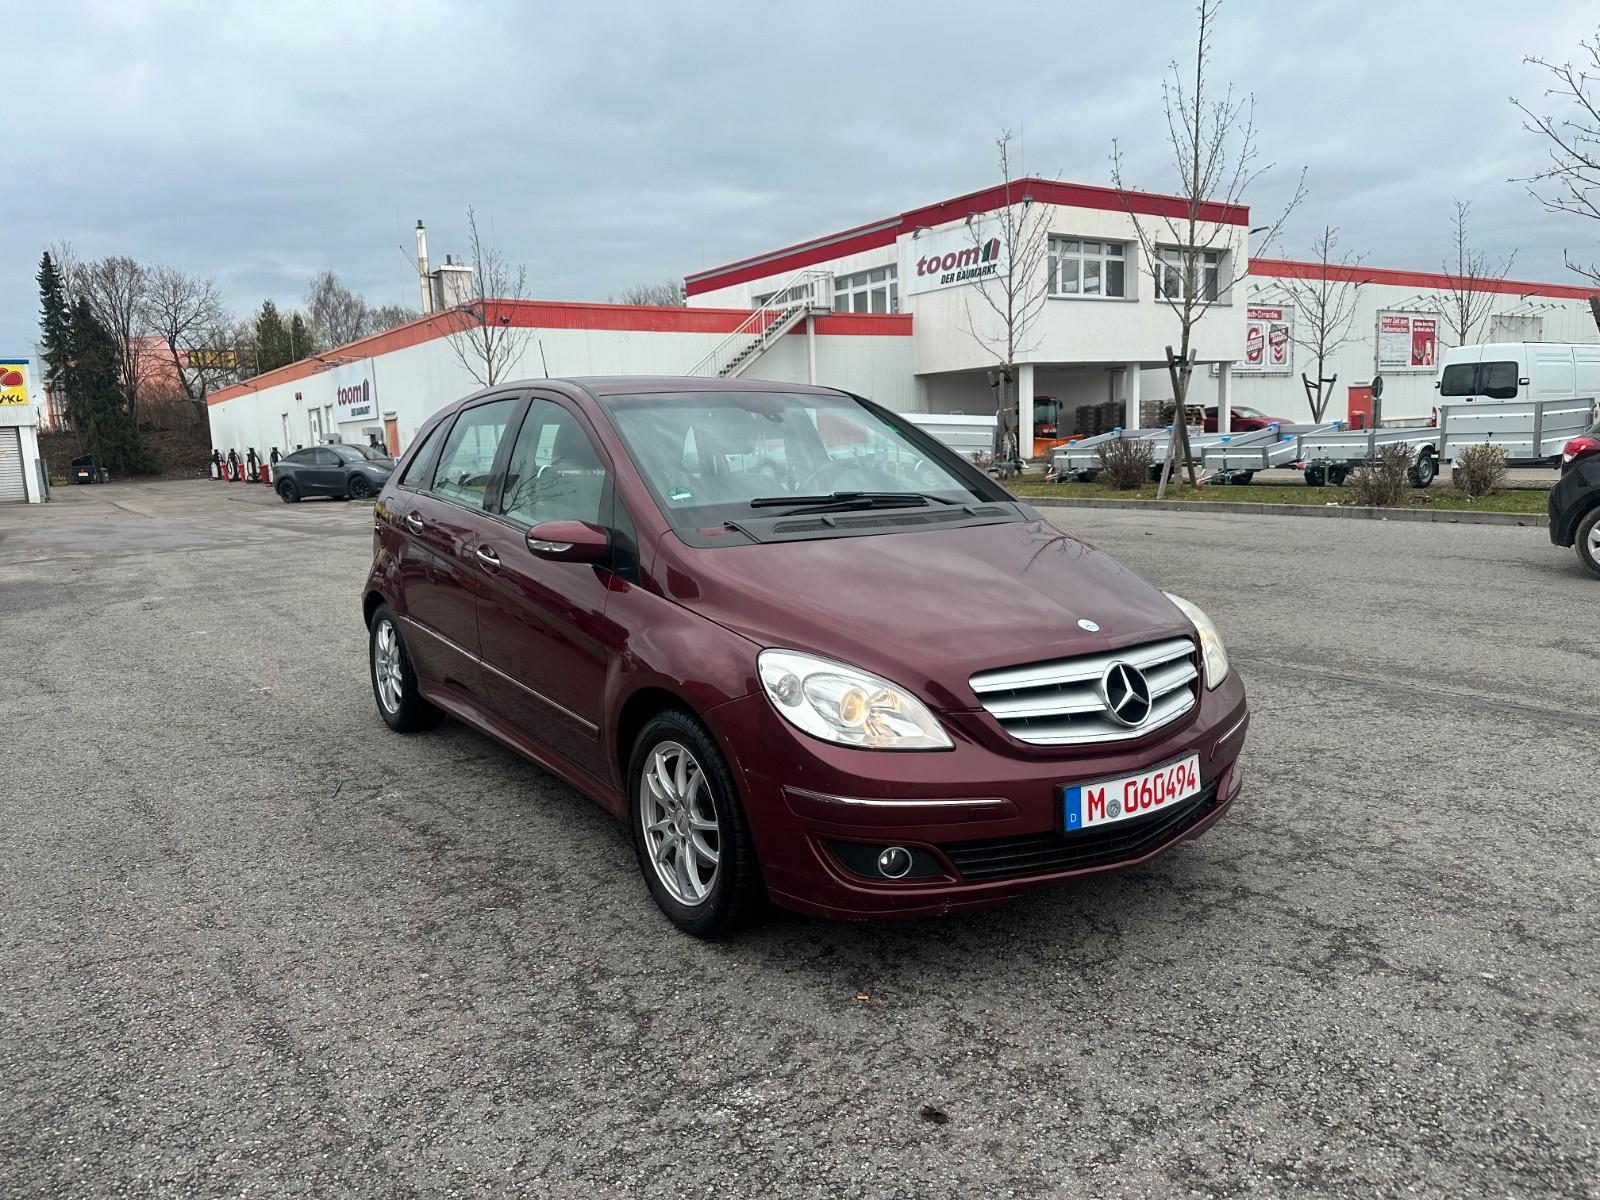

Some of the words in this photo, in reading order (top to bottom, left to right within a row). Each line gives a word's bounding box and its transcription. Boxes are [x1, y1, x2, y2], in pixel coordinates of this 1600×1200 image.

[917, 246, 979, 277] toom
[940, 271, 954, 285] DER
[956, 263, 998, 281] BAUMARKT
[337, 385, 362, 406] toom
[1087, 787, 1105, 821] M
[1123, 759, 1196, 813] 060494
[1070, 813, 1077, 823] D
